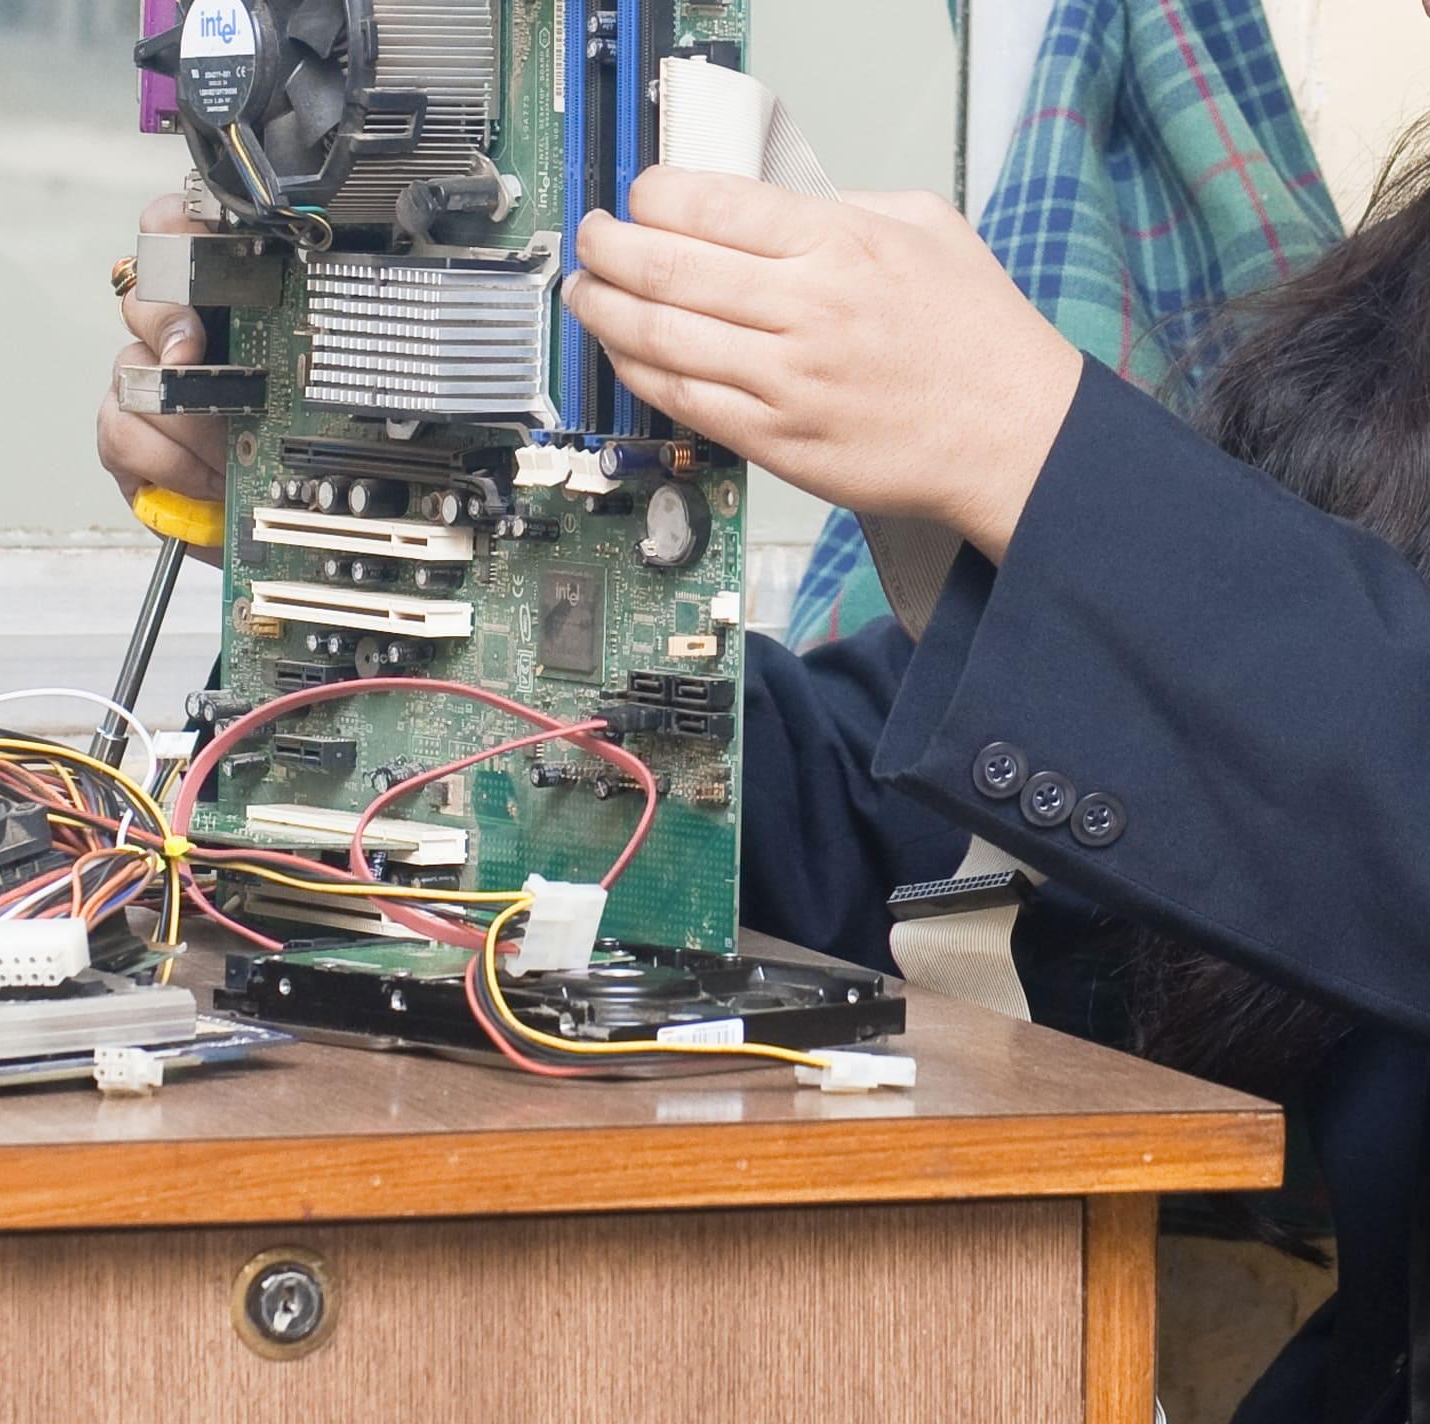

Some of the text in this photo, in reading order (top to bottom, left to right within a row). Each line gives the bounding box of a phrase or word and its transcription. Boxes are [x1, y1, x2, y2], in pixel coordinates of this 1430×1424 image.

[201, 9, 237, 44] intel
[538, 171, 550, 209] intel
[555, 582, 580, 606] intel
